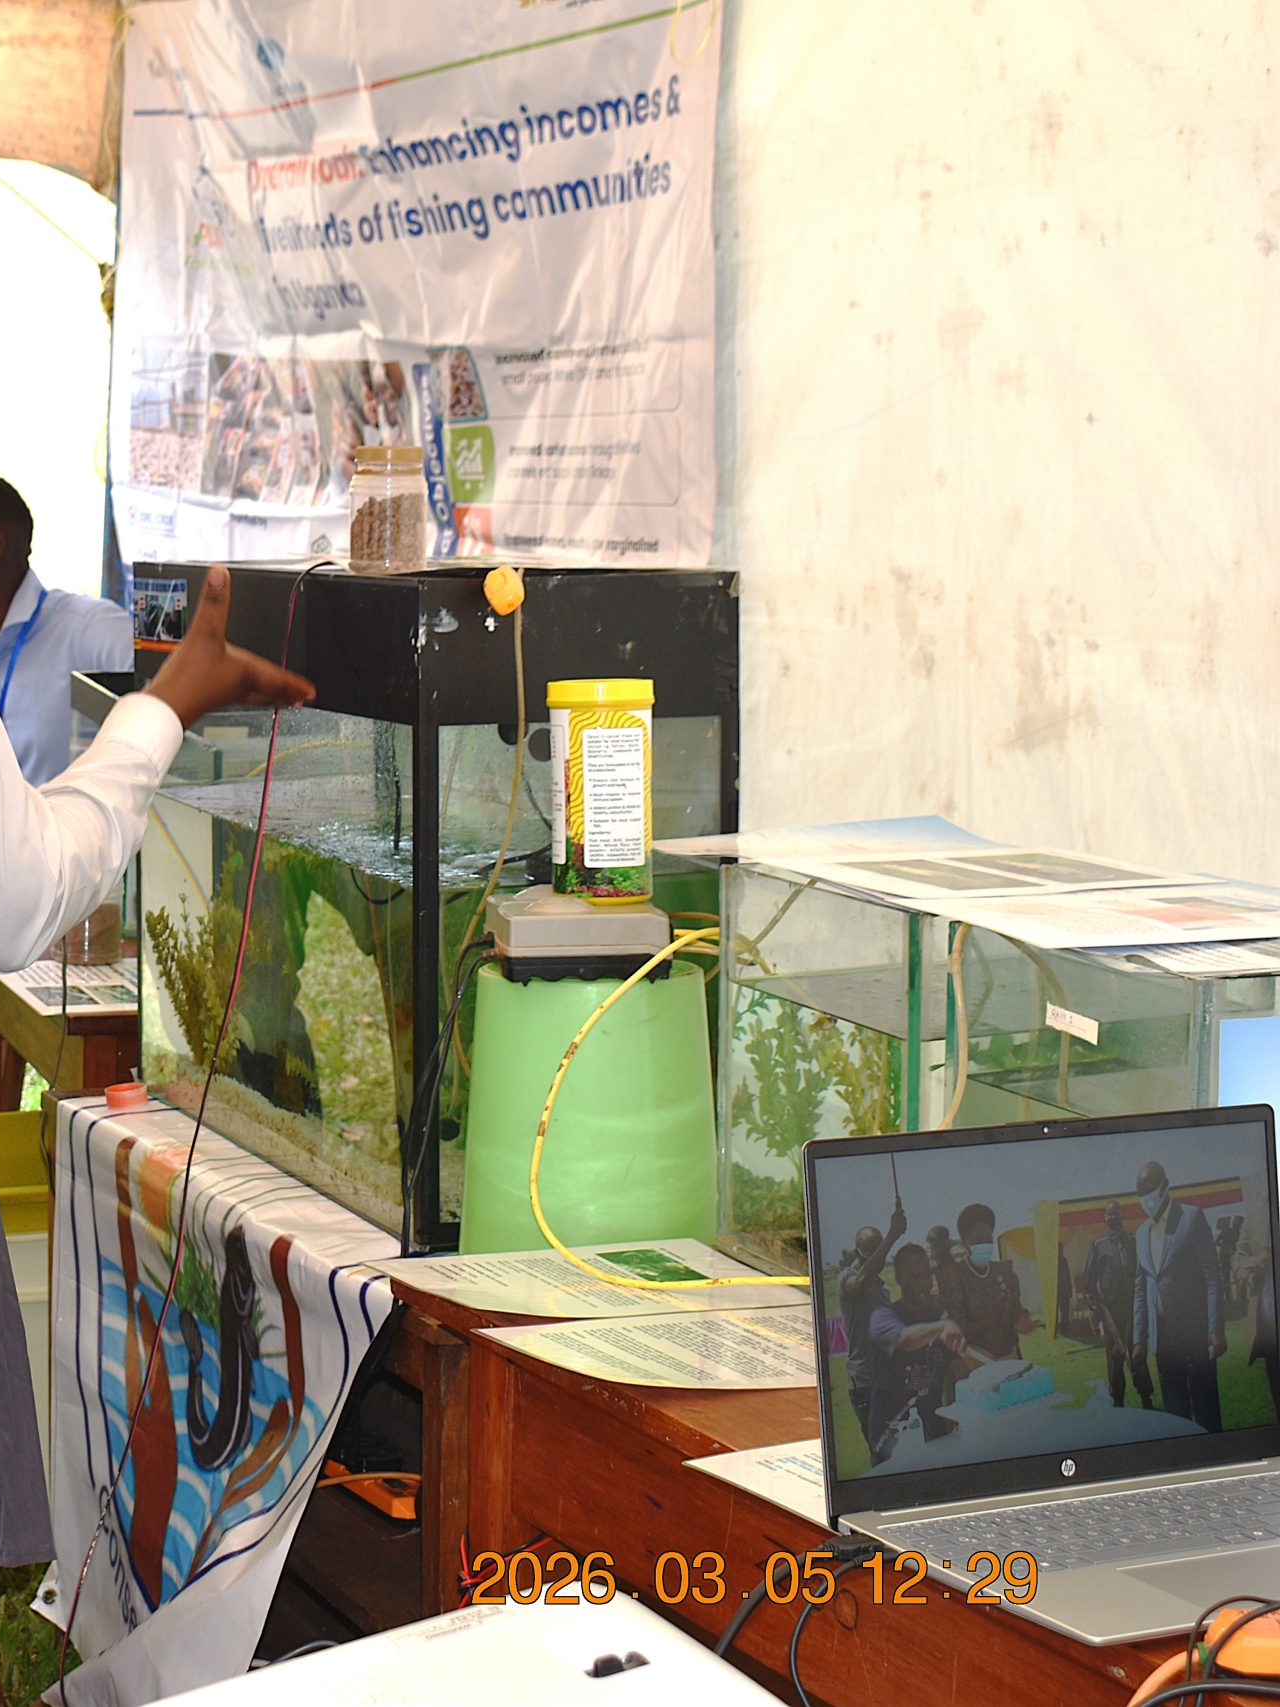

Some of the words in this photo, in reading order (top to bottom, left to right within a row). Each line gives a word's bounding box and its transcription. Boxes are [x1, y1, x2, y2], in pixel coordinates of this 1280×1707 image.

[519, 87, 662, 144] incomes
[666, 74, 682, 117] &
[358, 203, 384, 245] of
[388, 193, 491, 240] fishing
[493, 152, 671, 222] communities
[1063, 1459, 1075, 1476] hp
